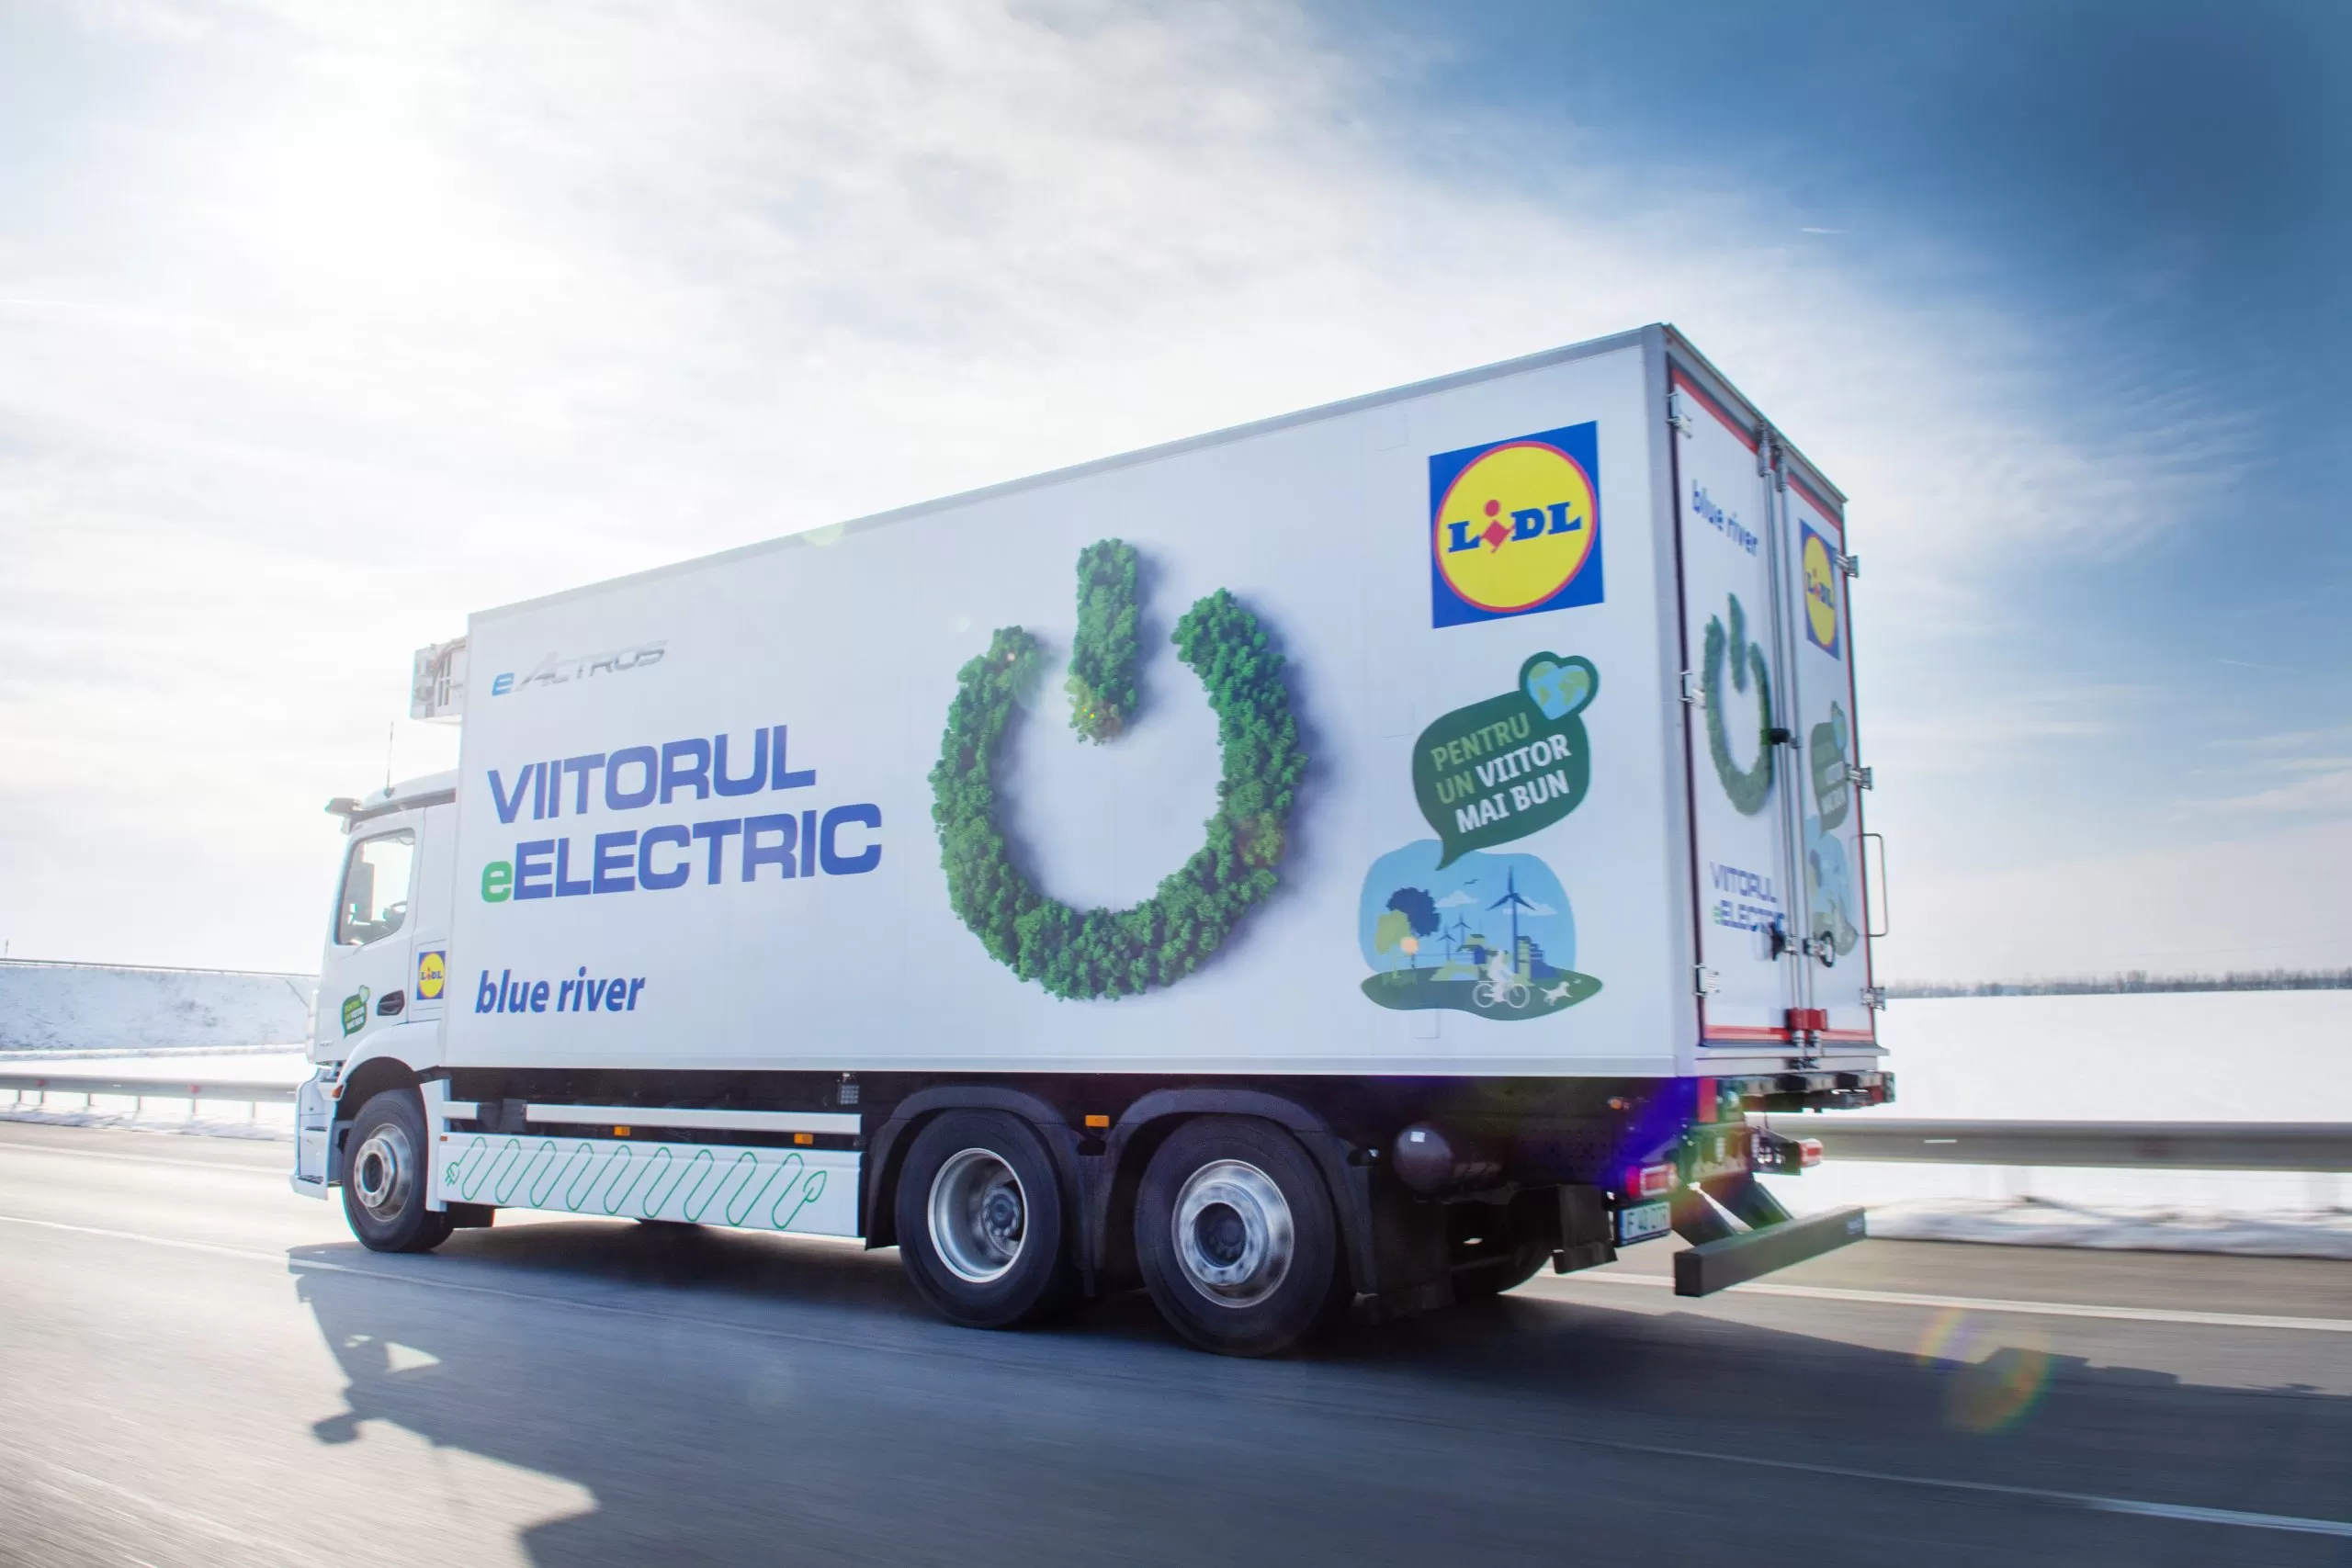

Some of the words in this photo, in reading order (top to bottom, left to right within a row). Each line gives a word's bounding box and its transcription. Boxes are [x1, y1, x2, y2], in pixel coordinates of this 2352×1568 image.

[487, 724, 817, 824] VIITORUL
[1430, 712, 1531, 772] PENTRU
[1435, 770, 1476, 805] UN
[1476, 733, 1573, 788] VIITOR
[1454, 792, 1510, 834] MAI
[1514, 769, 1571, 812] BUN
[481, 802, 883, 904] eELECTRIC
[475, 969, 550, 1013] blue
[557, 965, 647, 1012] river
